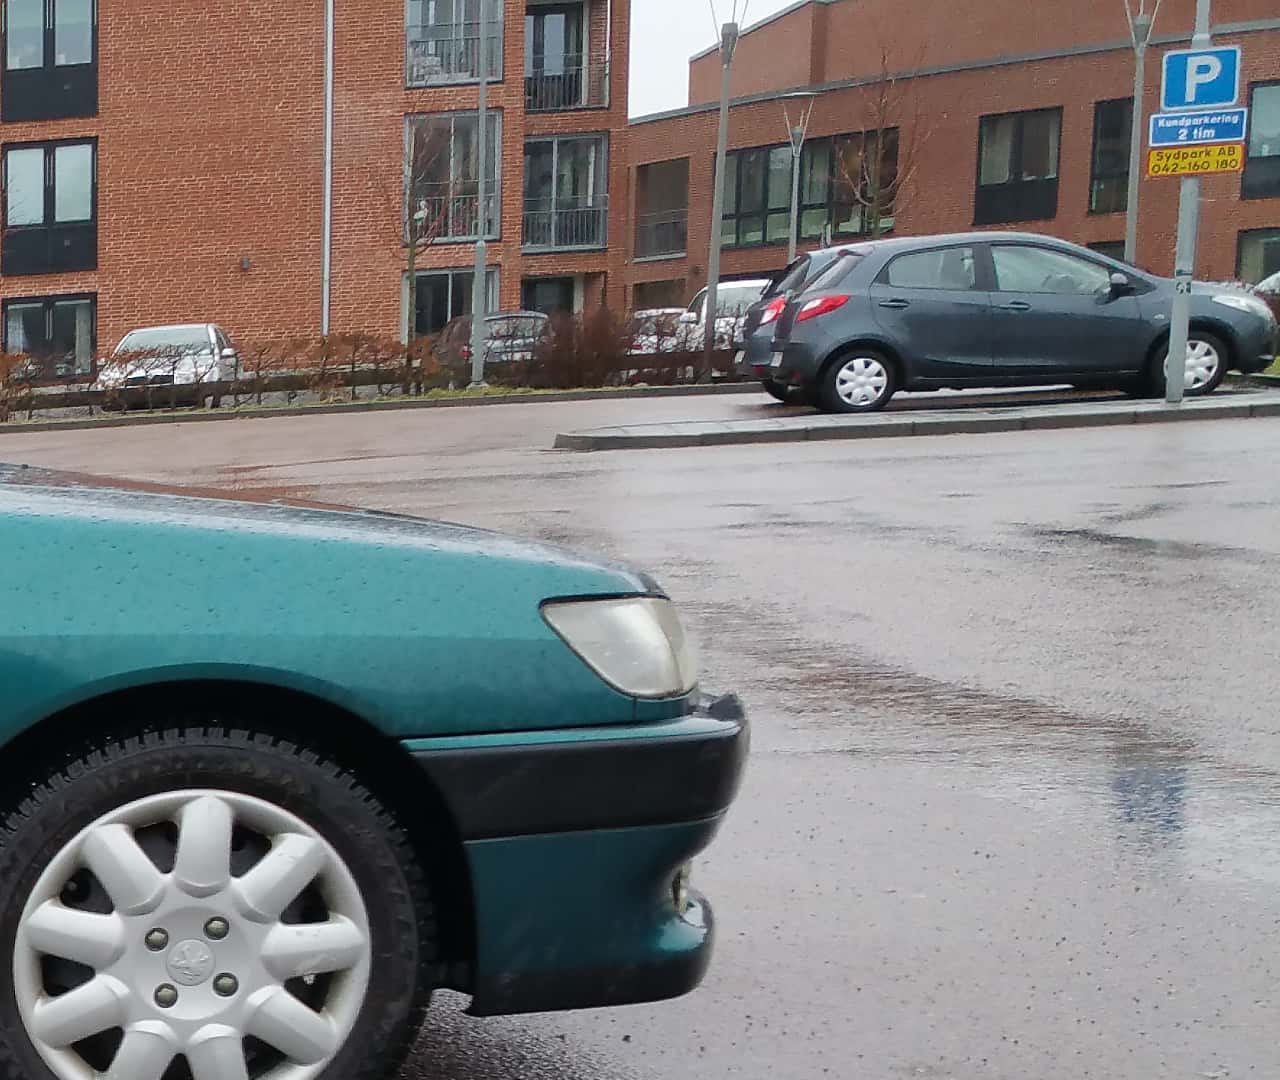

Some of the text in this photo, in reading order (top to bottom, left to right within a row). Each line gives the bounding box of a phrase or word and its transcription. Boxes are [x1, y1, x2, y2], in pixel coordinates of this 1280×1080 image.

[1185, 55, 1222, 102] P
[1158, 114, 1239, 127] Kundparkering
[1178, 127, 1215, 140] 2 tim
[1156, 146, 1236, 162] Sydpark AB
[1152, 159, 1238, 173] 042-160 180
